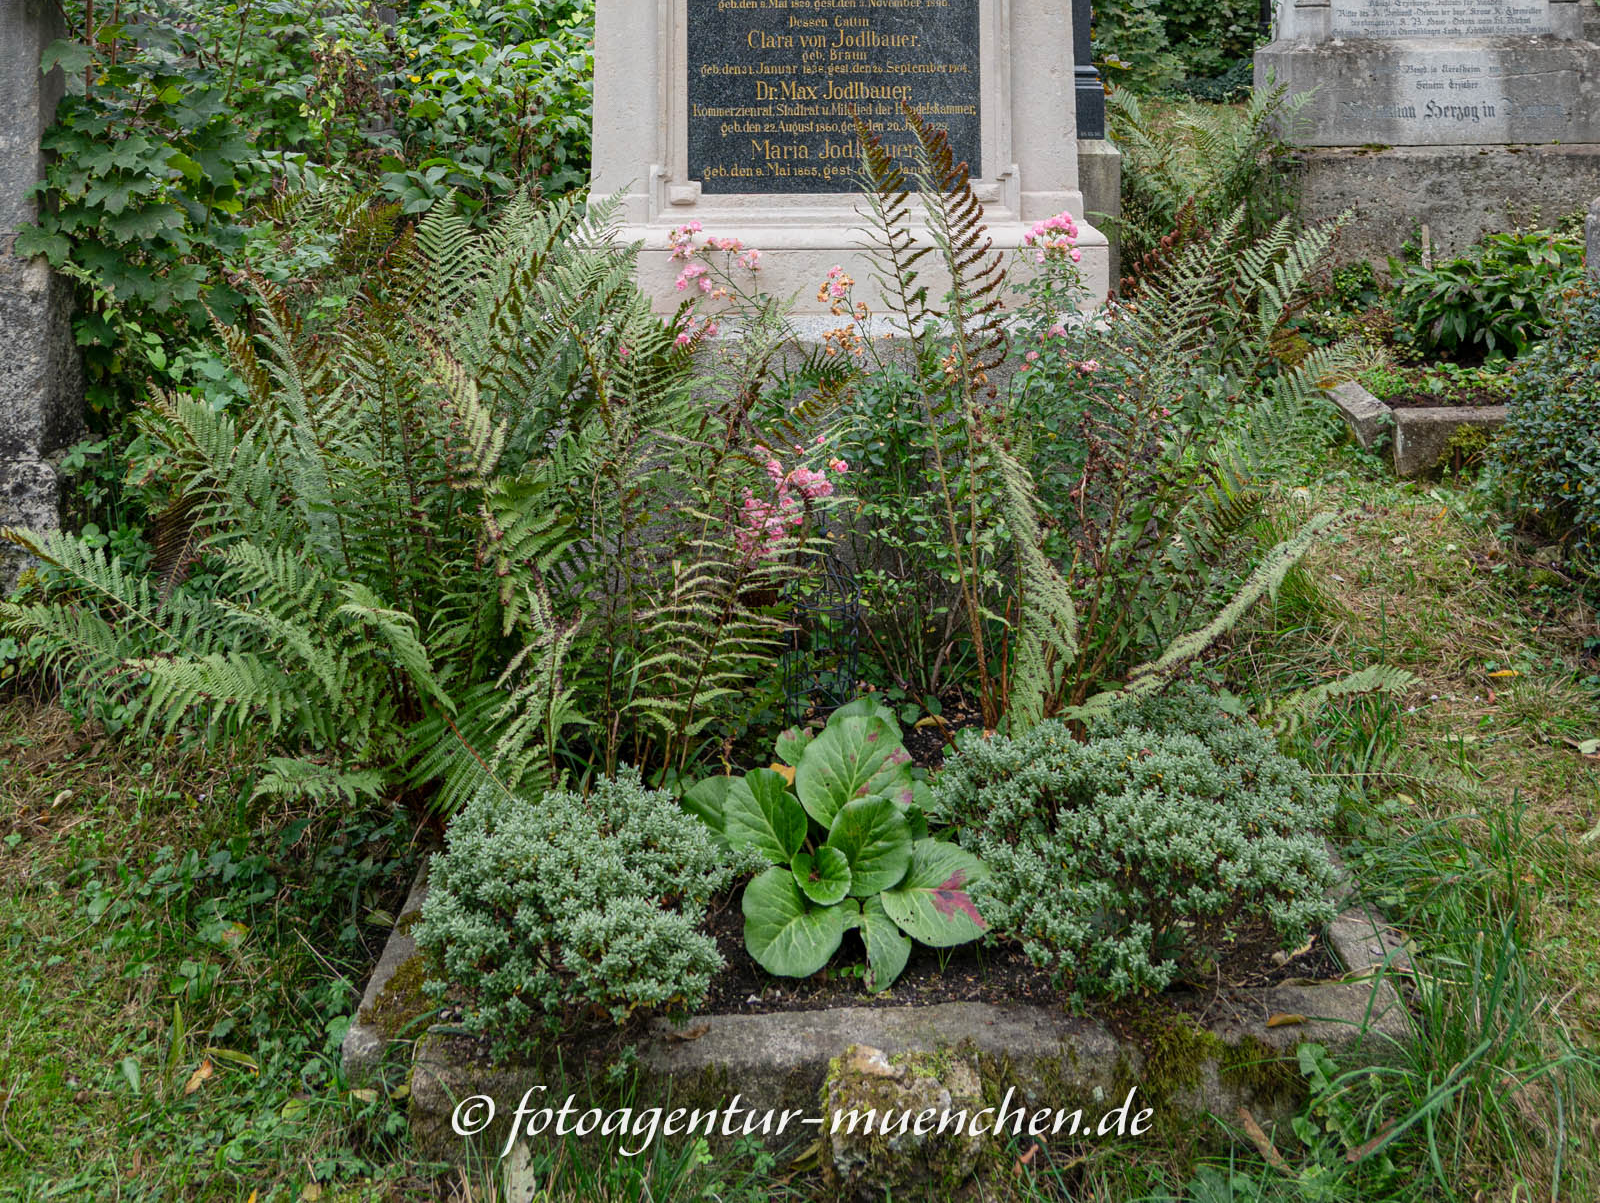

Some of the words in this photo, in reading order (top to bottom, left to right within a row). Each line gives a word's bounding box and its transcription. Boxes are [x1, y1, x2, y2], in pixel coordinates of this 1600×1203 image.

[789, 15, 828, 28] Dessen
[834, 15, 869, 28] Gattin
[747, 30, 793, 49] Clara
[800, 34, 827, 48] von
[830, 48, 867, 61] Braun
[755, 61, 798, 75] Januar
[886, 61, 947, 77] September
[780, 80, 818, 100] Max
[823, 80, 912, 101] Jodlbauer,
[875, 102, 892, 115] der
[894, 101, 977, 116] Hndelskammer,
[1424, 99, 1480, 123] Herzog
[1481, 101, 1496, 118] in
[779, 120, 814, 135] August
[751, 138, 809, 159] Maria
[818, 138, 919, 160] Jodluer,
[731, 163, 753, 177] den
[767, 162, 790, 176] Mai
